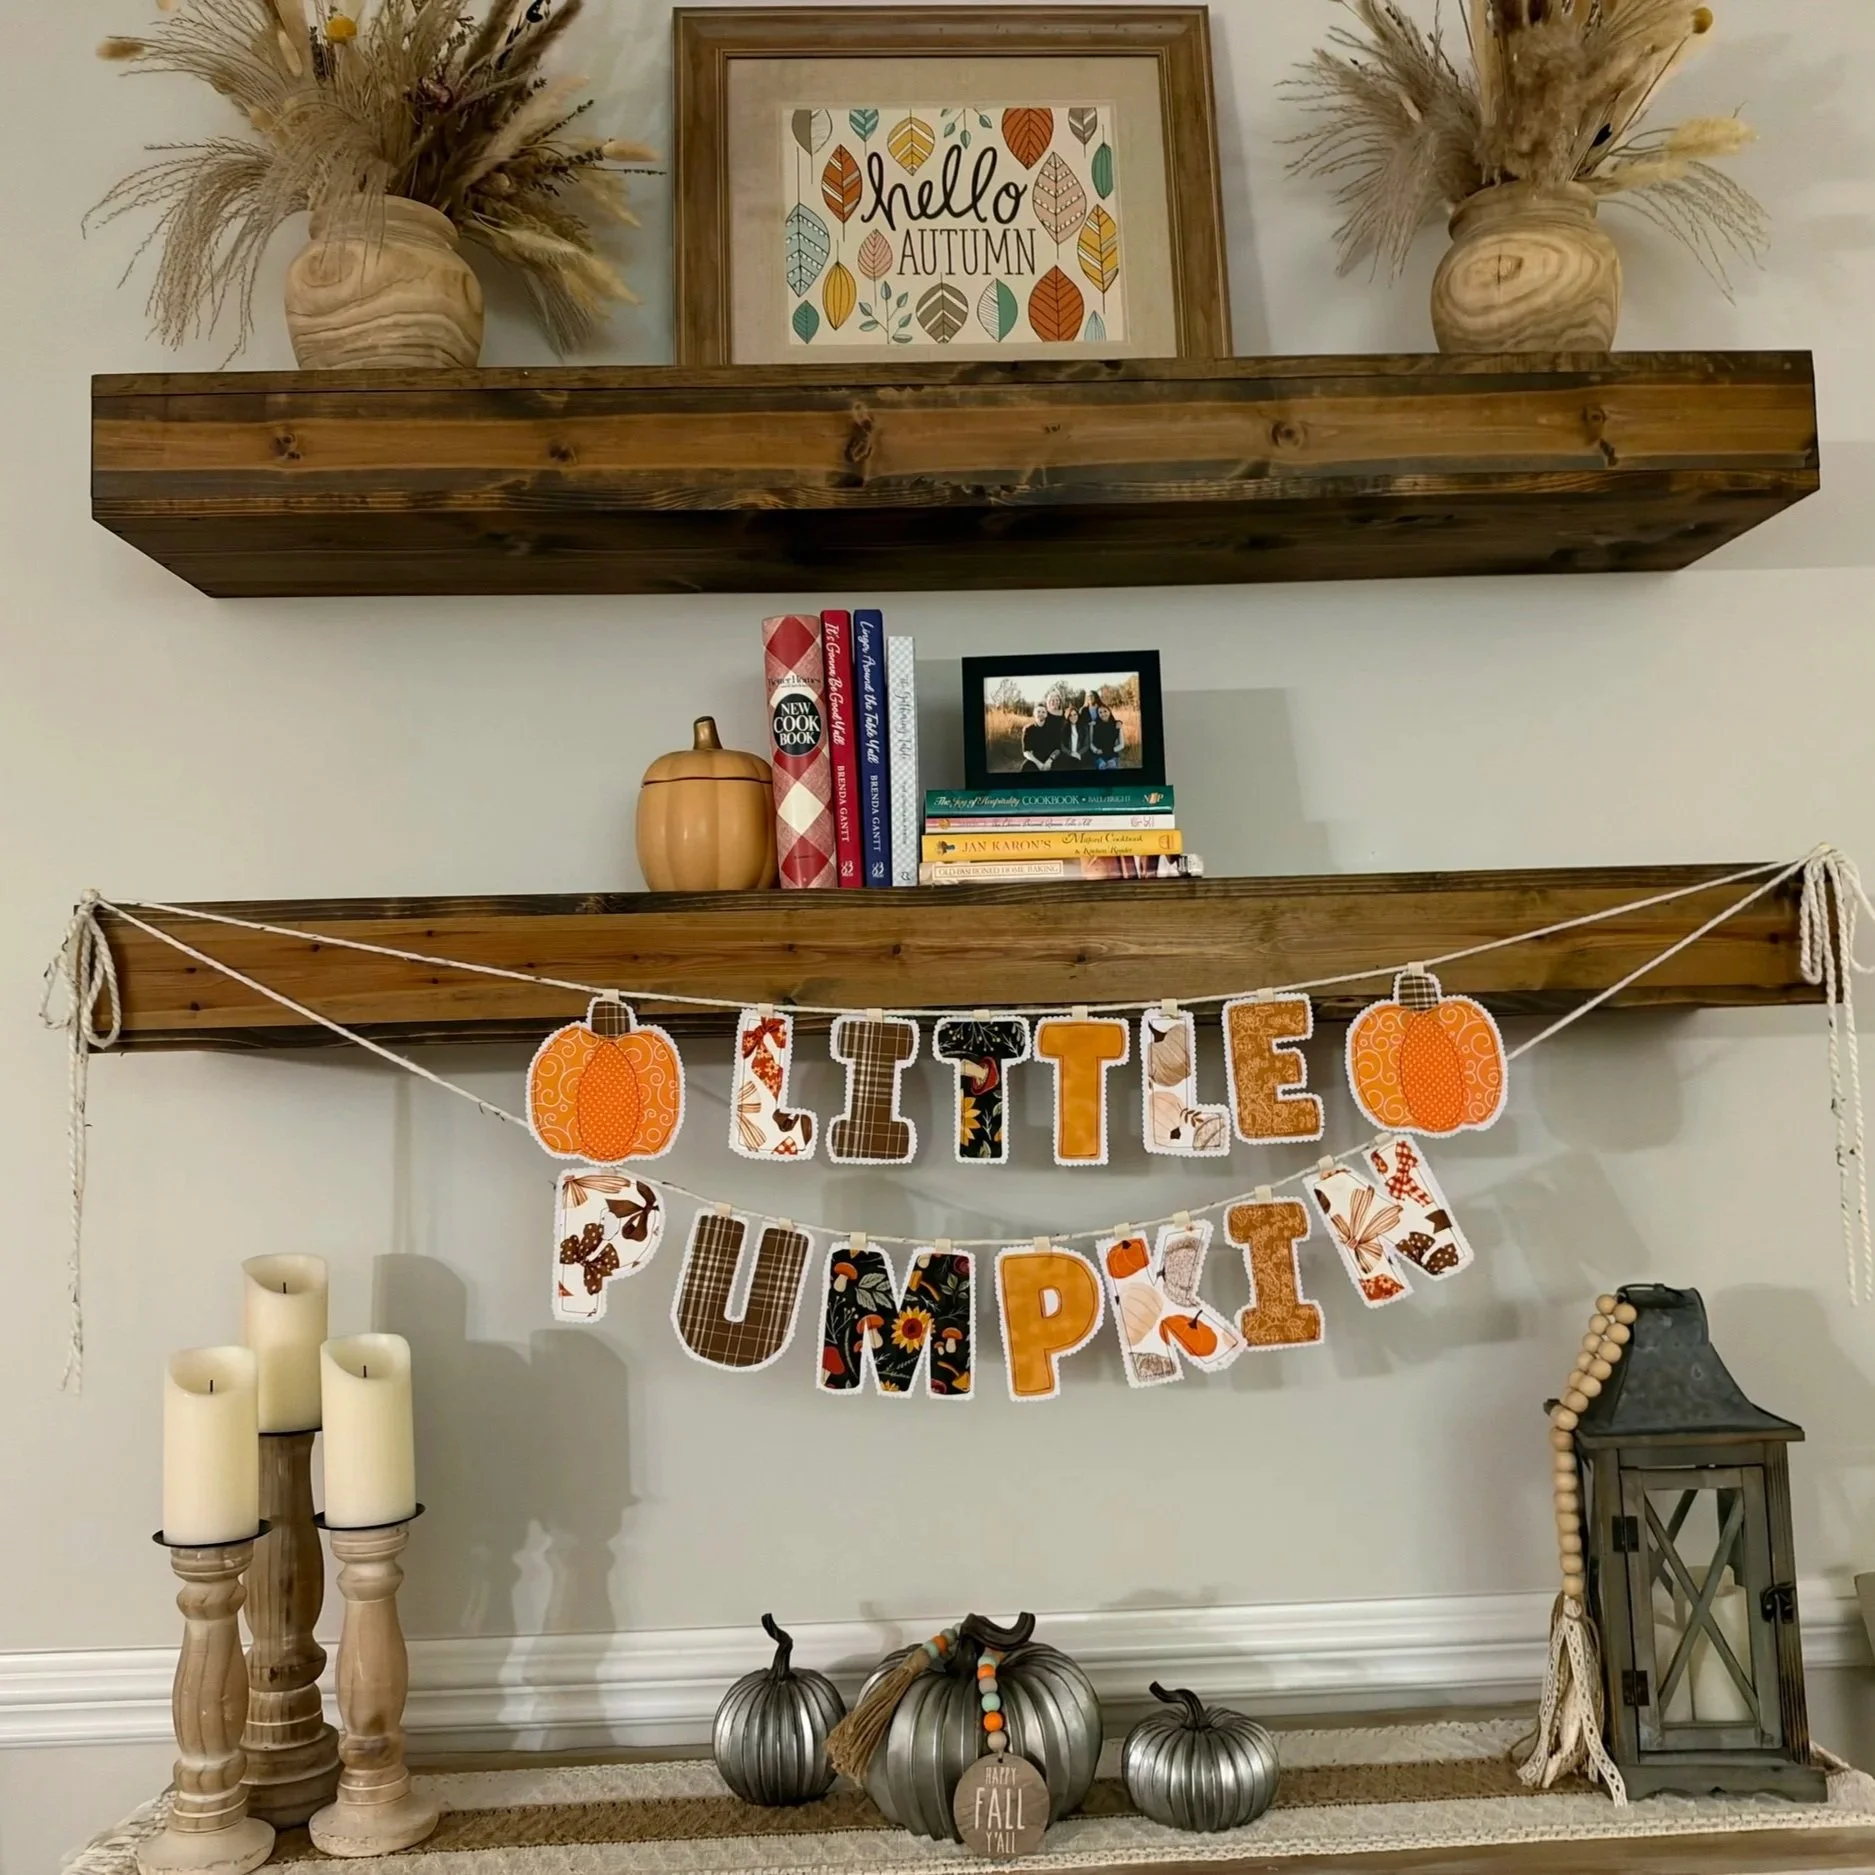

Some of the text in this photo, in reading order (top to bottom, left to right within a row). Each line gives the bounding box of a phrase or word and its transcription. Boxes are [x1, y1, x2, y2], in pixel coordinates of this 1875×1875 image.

[861, 144, 1028, 231] hello
[896, 228, 1036, 275] AUTUMN
[825, 622, 846, 745] It's Gonna Be Good Y'all
[858, 621, 880, 764] Linger Around the Table Y'all
[774, 715, 820, 733] COOK
[781, 702, 811, 716] NEW
[780, 731, 816, 746] BOOK
[837, 766, 850, 842] BRENDA GANTT
[870, 775, 881, 852] BRENDA GANTT
[934, 796, 950, 806] The
[967, 796, 979, 808] of
[1022, 795, 1080, 805] COOKBOOK
[962, 841, 986, 852] JAN
[992, 839, 1051, 851] KARON'S
[1027, 865, 1058, 873] BAKING
[729, 993, 1326, 1167] LITTLE
[552, 1134, 1475, 1402] PUMPKIN
[985, 1767, 1017, 1785] HAPPY
[975, 1787, 1025, 1830] FALL
[986, 1832, 1016, 1853] Y'ALL
